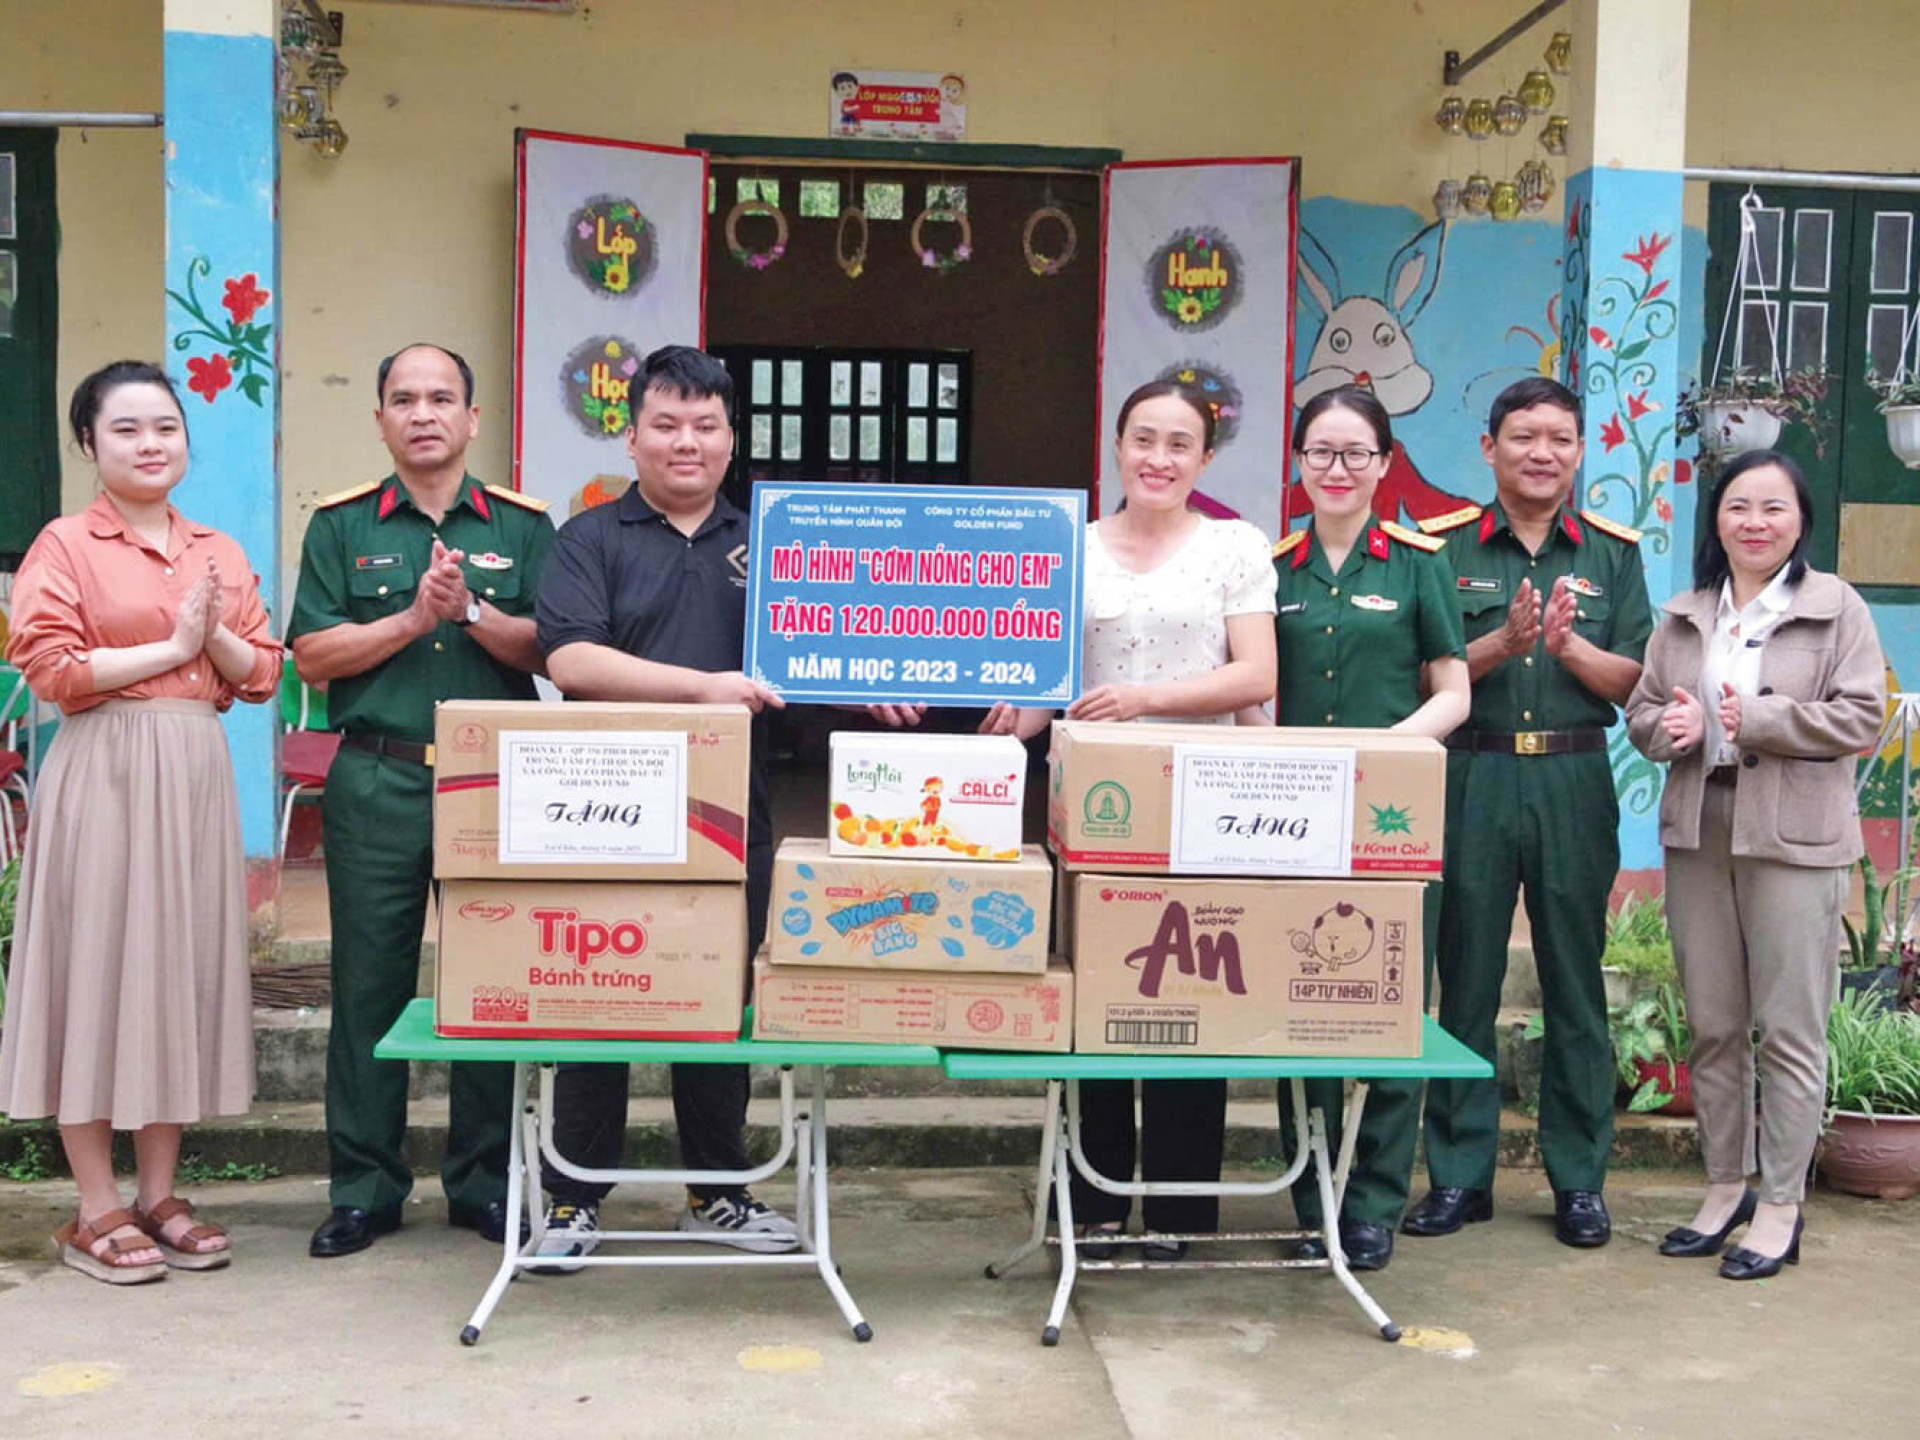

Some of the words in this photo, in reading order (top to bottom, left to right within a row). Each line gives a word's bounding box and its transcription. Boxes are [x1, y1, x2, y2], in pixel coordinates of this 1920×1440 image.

[595, 216, 637, 268] Lớp
[1168, 250, 1227, 294] Hạnh
[786, 503, 819, 514] TRUNG
[822, 503, 843, 515] TÂM
[844, 505, 871, 515] PHÁT
[873, 506, 907, 515] THANH
[856, 517, 884, 528] QUÂN
[924, 505, 952, 516] CÔNG
[955, 507, 968, 516] TY
[954, 519, 995, 529] GOLDEN
[996, 520, 1024, 530] FUND
[772, 541, 802, 582] MÔ
[807, 542, 854, 583] HÌNH
[860, 547, 913, 585] "CƠM
[918, 543, 972, 586] NÓNG
[977, 551, 1015, 587] CHO
[1020, 552, 1062, 588] EM"
[768, 598, 833, 641] TẶNG
[840, 604, 988, 637] 120.000.000
[993, 599, 1062, 641] ĐỒNG
[787, 653, 842, 681] NĂM
[849, 659, 895, 687] HỌC
[901, 660, 957, 683] 2023
[979, 662, 1036, 685] 2024
[961, 782, 1009, 798] CALCI
[545, 799, 642, 828] TẶNG
[1216, 812, 1309, 841] TẶNG
[1118, 890, 1163, 902] ORION
[530, 909, 647, 967] Tipo
[528, 967, 586, 986] Bánh
[591, 968, 652, 992] trứng
